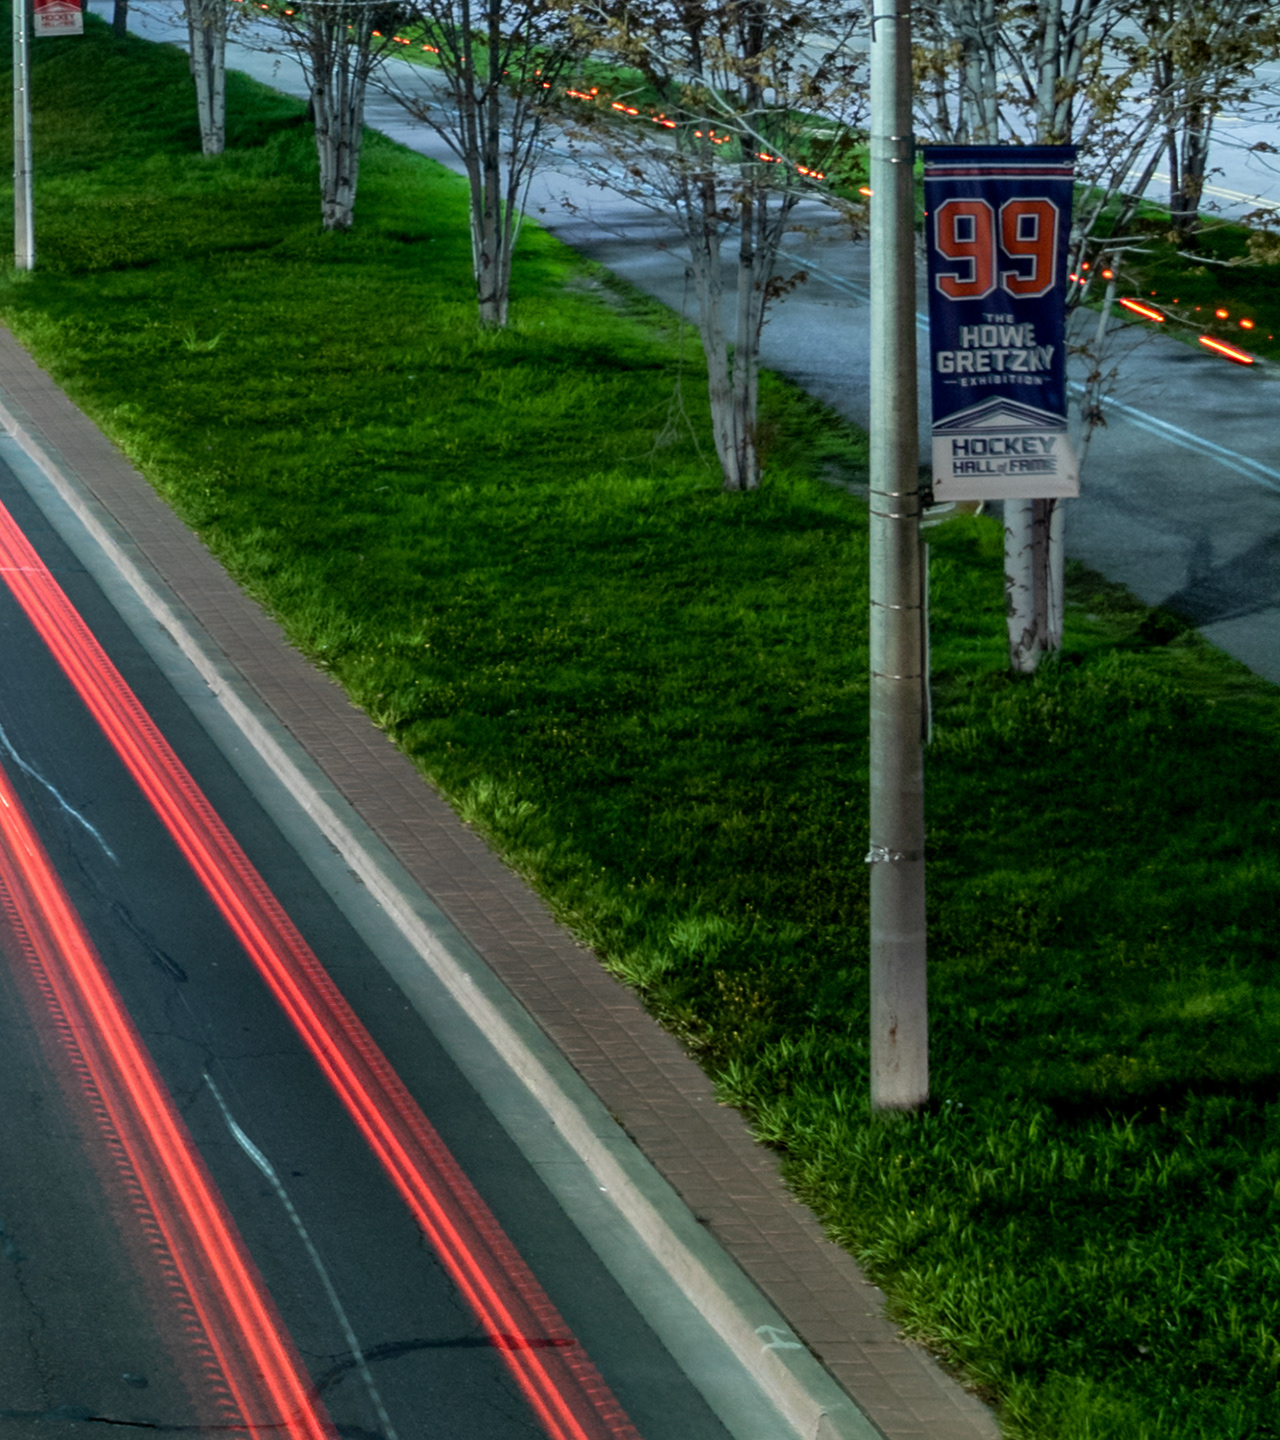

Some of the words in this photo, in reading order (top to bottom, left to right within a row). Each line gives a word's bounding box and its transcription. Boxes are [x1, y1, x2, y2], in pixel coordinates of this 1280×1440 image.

[934, 197, 1060, 301] 99
[984, 313, 1015, 323] THE
[960, 323, 1037, 348] HOWE
[937, 345, 1055, 373] GRETZKY
[960, 375, 1043, 387] EXHIBITION
[952, 436, 1057, 457] HOCKEY
[953, 461, 996, 474] HALL
[1009, 458, 1058, 472] FAME
